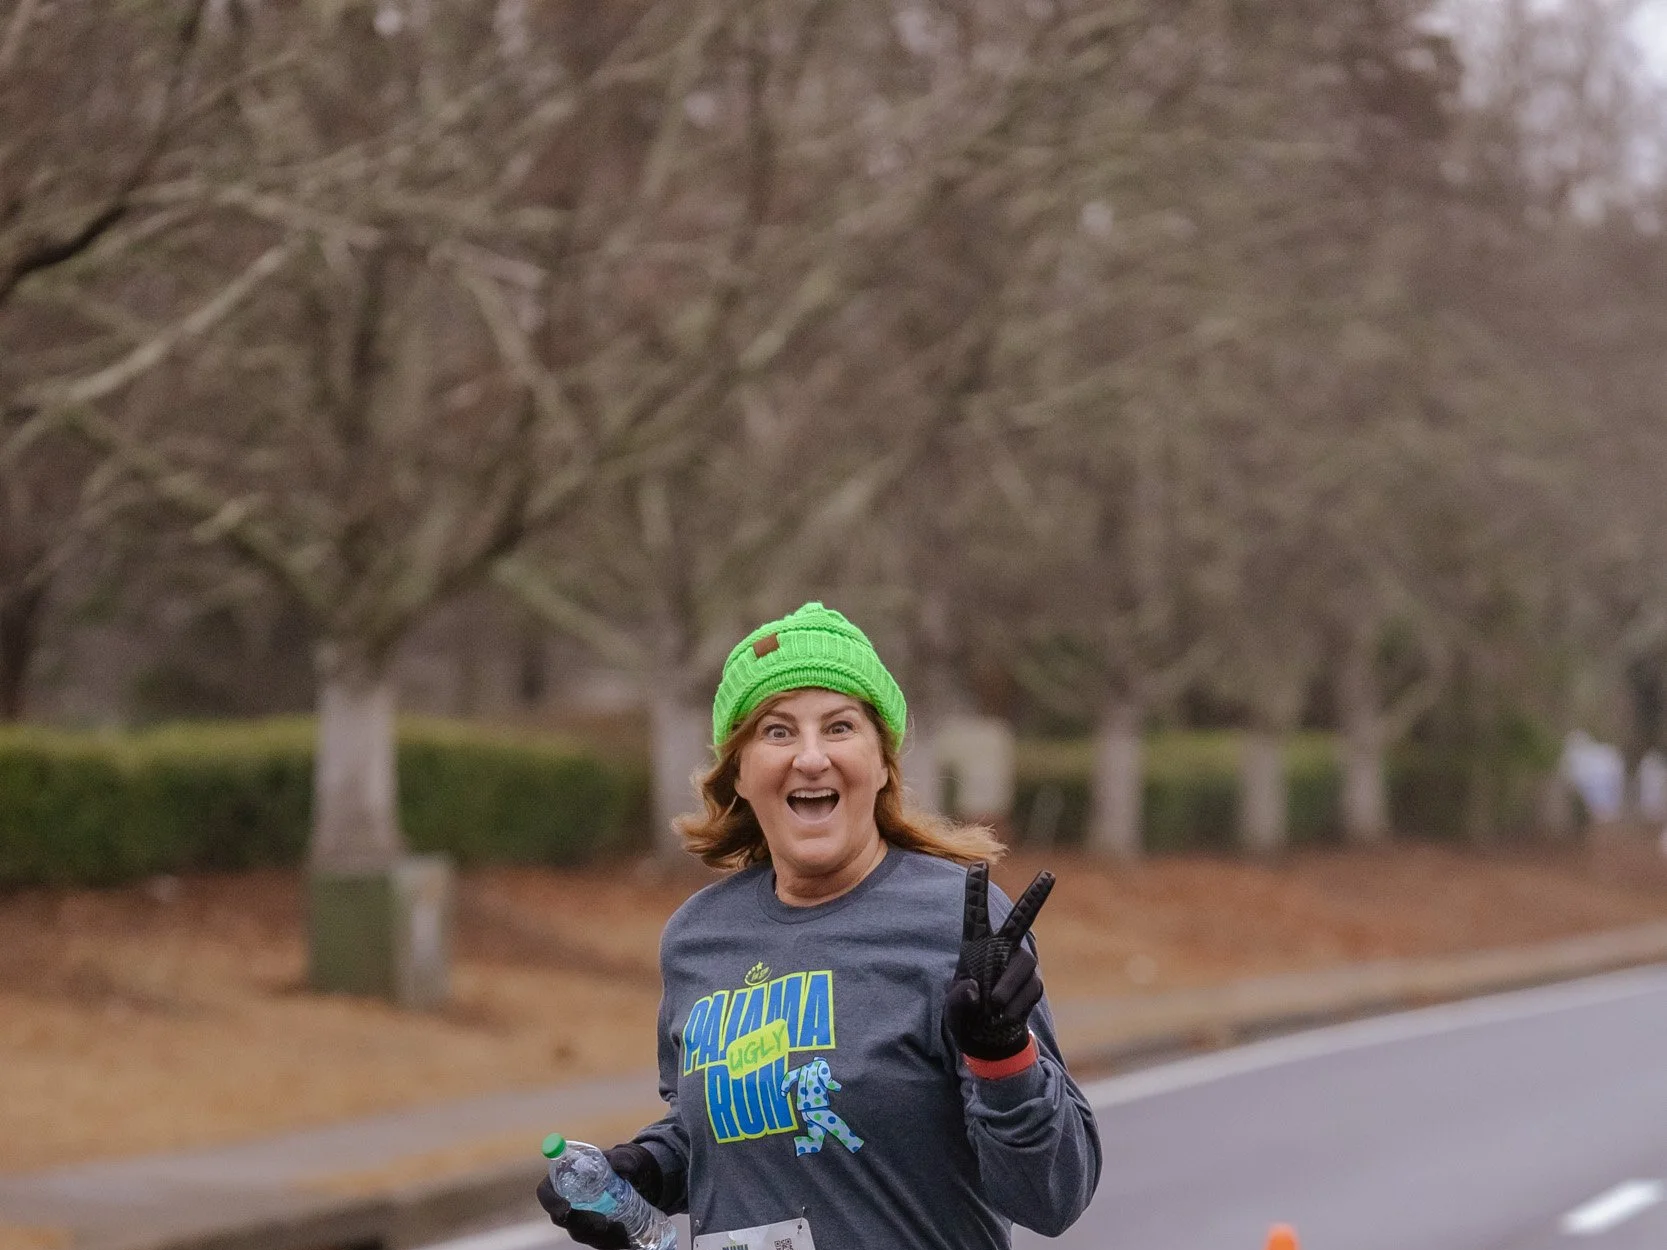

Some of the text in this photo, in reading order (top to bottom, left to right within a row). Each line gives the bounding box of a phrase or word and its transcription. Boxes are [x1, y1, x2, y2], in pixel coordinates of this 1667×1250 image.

[684, 971, 834, 1075] PAJAMA
[729, 1025, 785, 1072] UGLY
[706, 1056, 796, 1141] RUN
